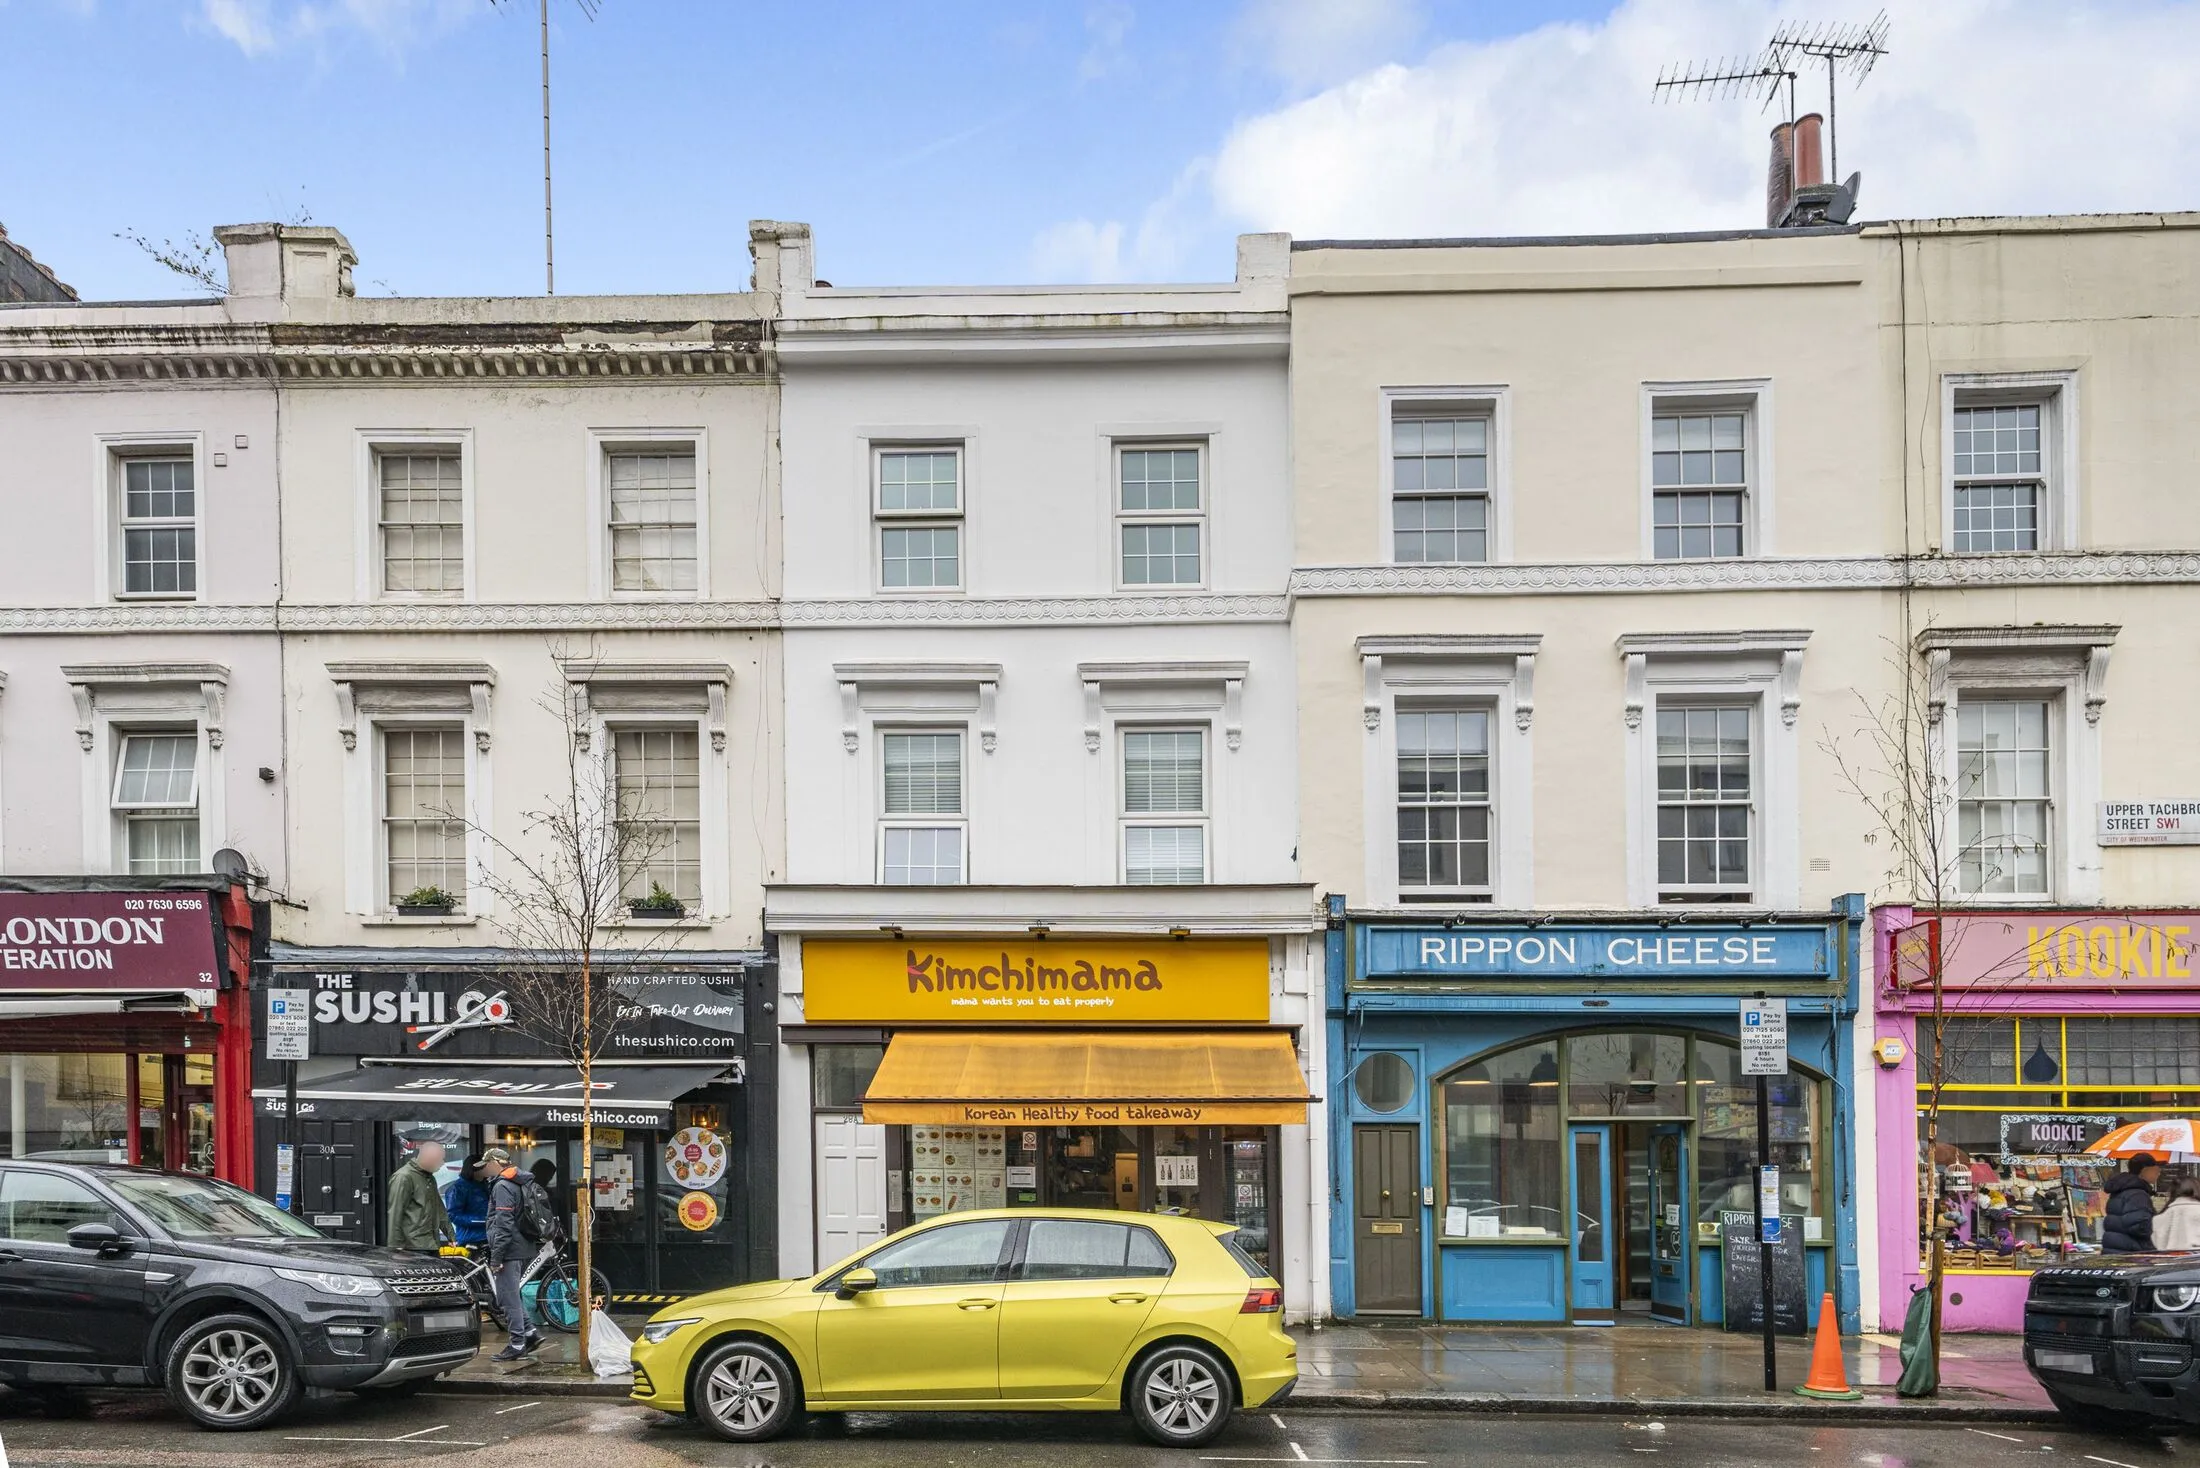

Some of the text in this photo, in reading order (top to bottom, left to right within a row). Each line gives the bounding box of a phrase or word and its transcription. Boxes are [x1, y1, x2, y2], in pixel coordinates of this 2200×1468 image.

[2107, 804, 2144, 815] UPPER
[2107, 818, 2179, 829] STREET SW1
[125, 900, 202, 909] 020 7630 6596
[1421, 937, 1776, 965] RIPPON CHEESE
[2028, 926, 2191, 979] KOOKIE
[906, 950, 1162, 993] Kimchimama
[199, 973, 212, 983] 32
[315, 974, 353, 988] THE
[608, 976, 734, 984] HAND CRAFTED SUSHI
[275, 1002, 283, 1012] P
[314, 991, 445, 1023] SUSHI
[952, 996, 1114, 1007] mama wants you to eat properly
[1749, 1014, 1758, 1024] P
[615, 1034, 734, 1046] thesushico.com
[265, 1102, 299, 1111] SUSI
[843, 1114, 859, 1124] 28A
[964, 1106, 1201, 1122] Korean Healthy food takeaway
[2031, 1124, 2085, 1141] KOOKIE
[320, 1146, 335, 1154] 30A
[2034, 1142, 2081, 1154] of London
[1724, 1212, 1754, 1225] RIPPON
